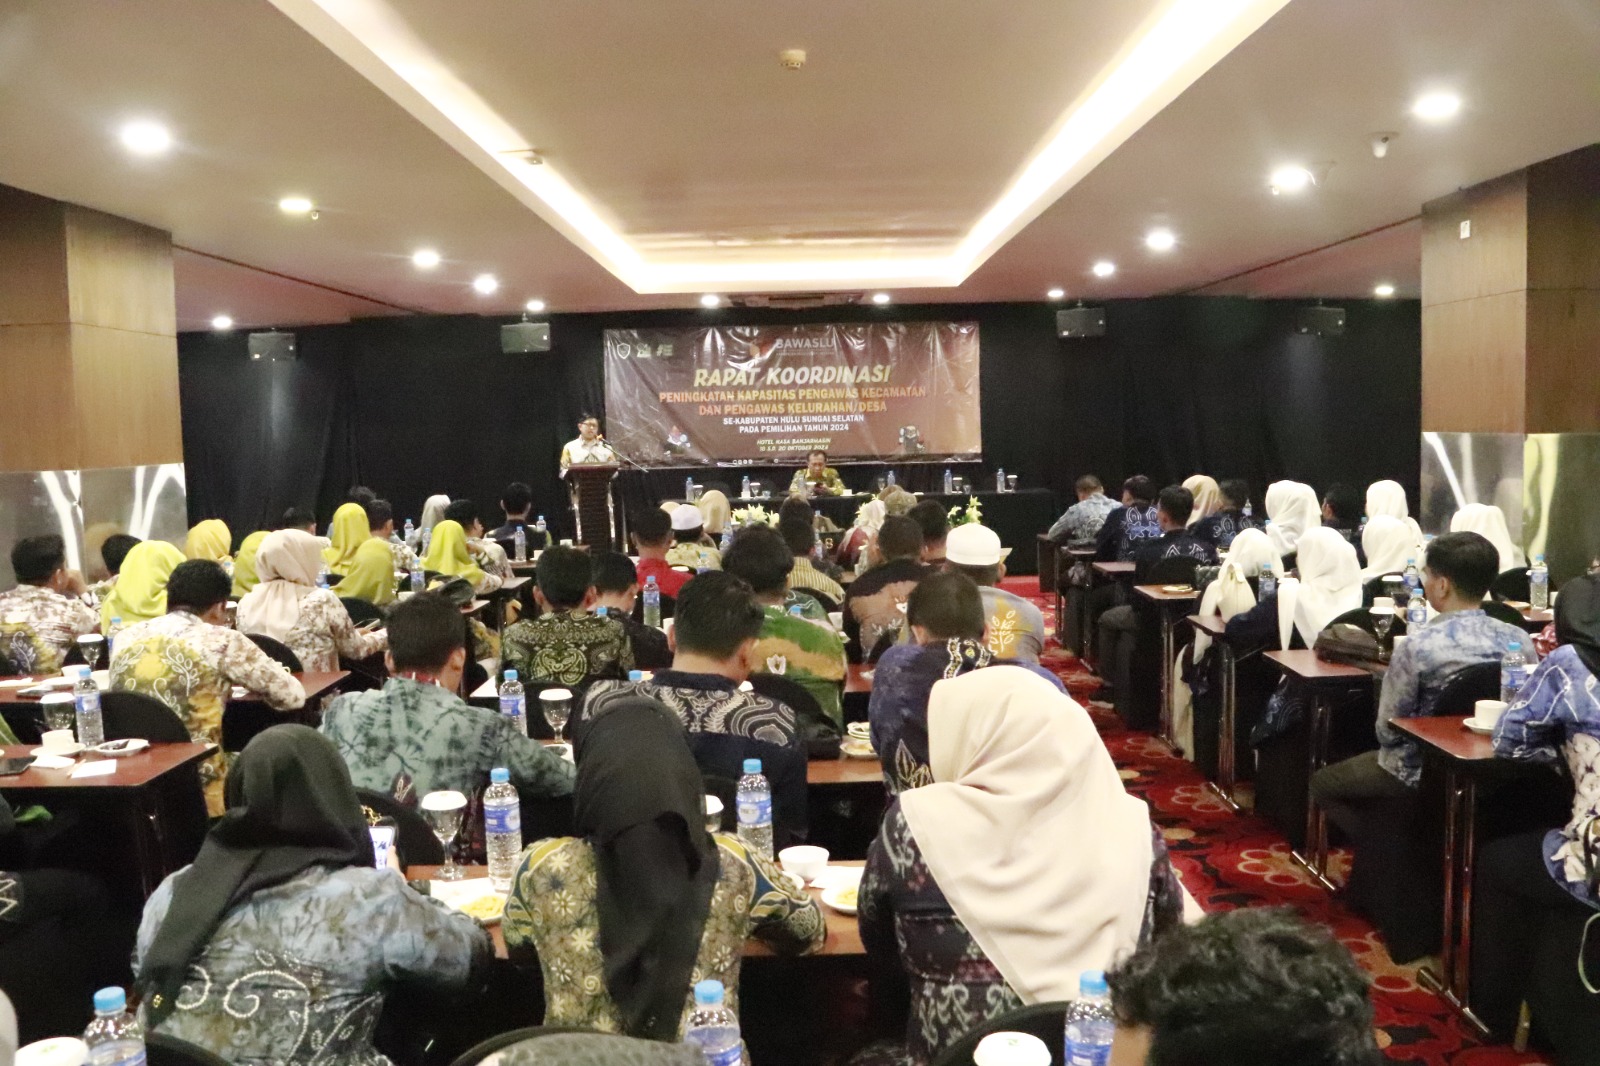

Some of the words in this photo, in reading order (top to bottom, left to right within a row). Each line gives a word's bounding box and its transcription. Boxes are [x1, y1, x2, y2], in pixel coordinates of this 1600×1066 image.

[776, 338, 834, 349] BAWASLU
[694, 367, 761, 387] RAPAT
[766, 364, 891, 385] KOORDINASI
[659, 390, 735, 403] PENINGKATAN
[737, 388, 796, 401] KAPASITAS
[800, 388, 859, 399] PENGAWAS
[862, 386, 926, 399] KECAMATAN
[699, 404, 722, 416] DAN
[724, 403, 785, 415] PENGAWAS
[723, 416, 778, 425] SE-KABUPATEN
[780, 415, 800, 423] HULU
[802, 415, 830, 423] SUNGAI
[832, 414, 864, 422] SELATAN
[739, 425, 759, 434] PADA
[761, 424, 802, 433] PEMILIHAN
[804, 423, 829, 431] TAHUN
[831, 423, 849, 431] 2024
